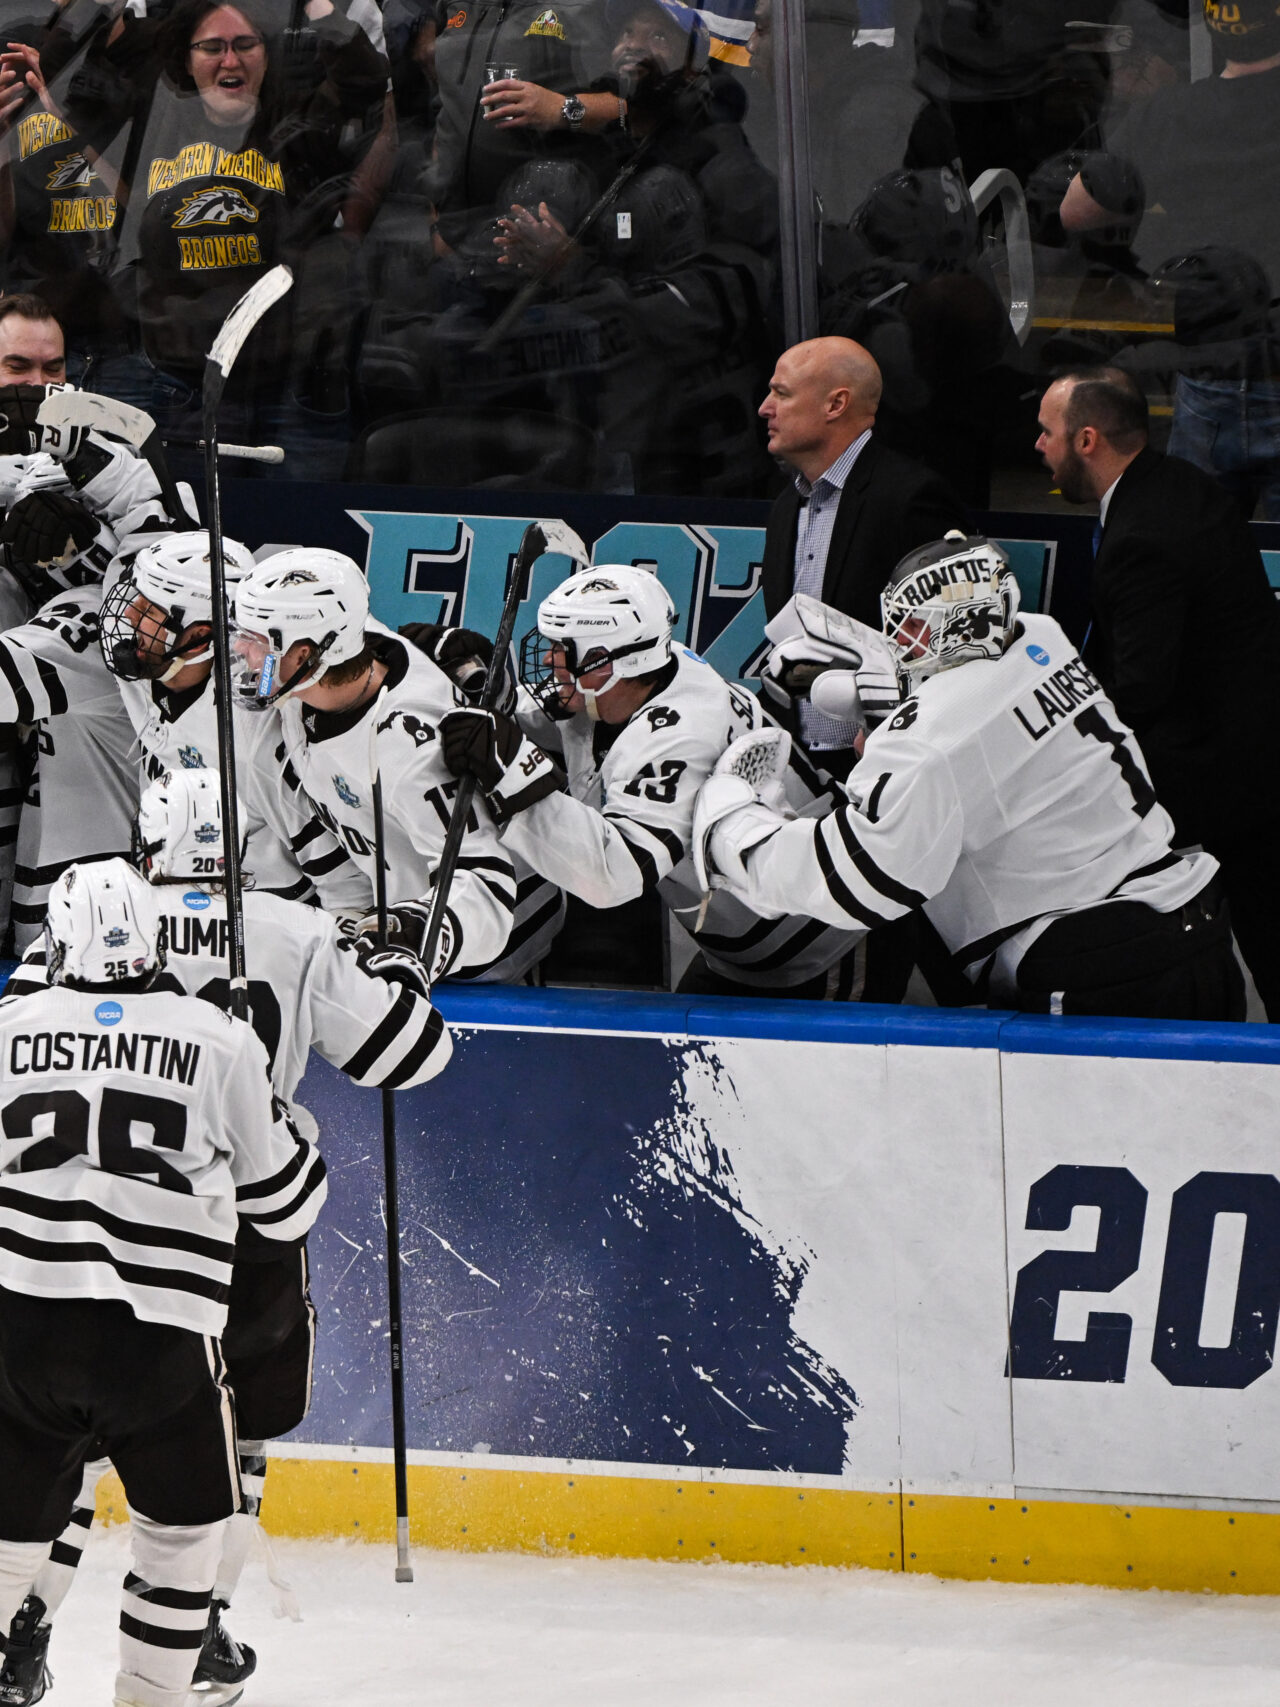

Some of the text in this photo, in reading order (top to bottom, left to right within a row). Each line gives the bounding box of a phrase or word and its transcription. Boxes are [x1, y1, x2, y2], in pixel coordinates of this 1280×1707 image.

[147, 141, 286, 199] WESTERN MICHIGAN
[47, 196, 118, 233] BRONCOS
[177, 233, 262, 270] BRONCOS
[576, 619, 611, 627] BAUER
[260, 655, 274, 696] BAUER
[584, 656, 610, 672] BAUER
[623, 759, 688, 804] 13
[1073, 703, 1157, 821] 1
[866, 772, 893, 825] 1
[192, 857, 215, 873] 20
[185, 897, 211, 907] NCAA
[104, 960, 129, 980] 25
[98, 1012, 121, 1020] NCAA
[9, 1031, 201, 1087] COSTANTINI
[1, 1087, 194, 1196] 25
[1003, 1163, 1280, 1390] 20
